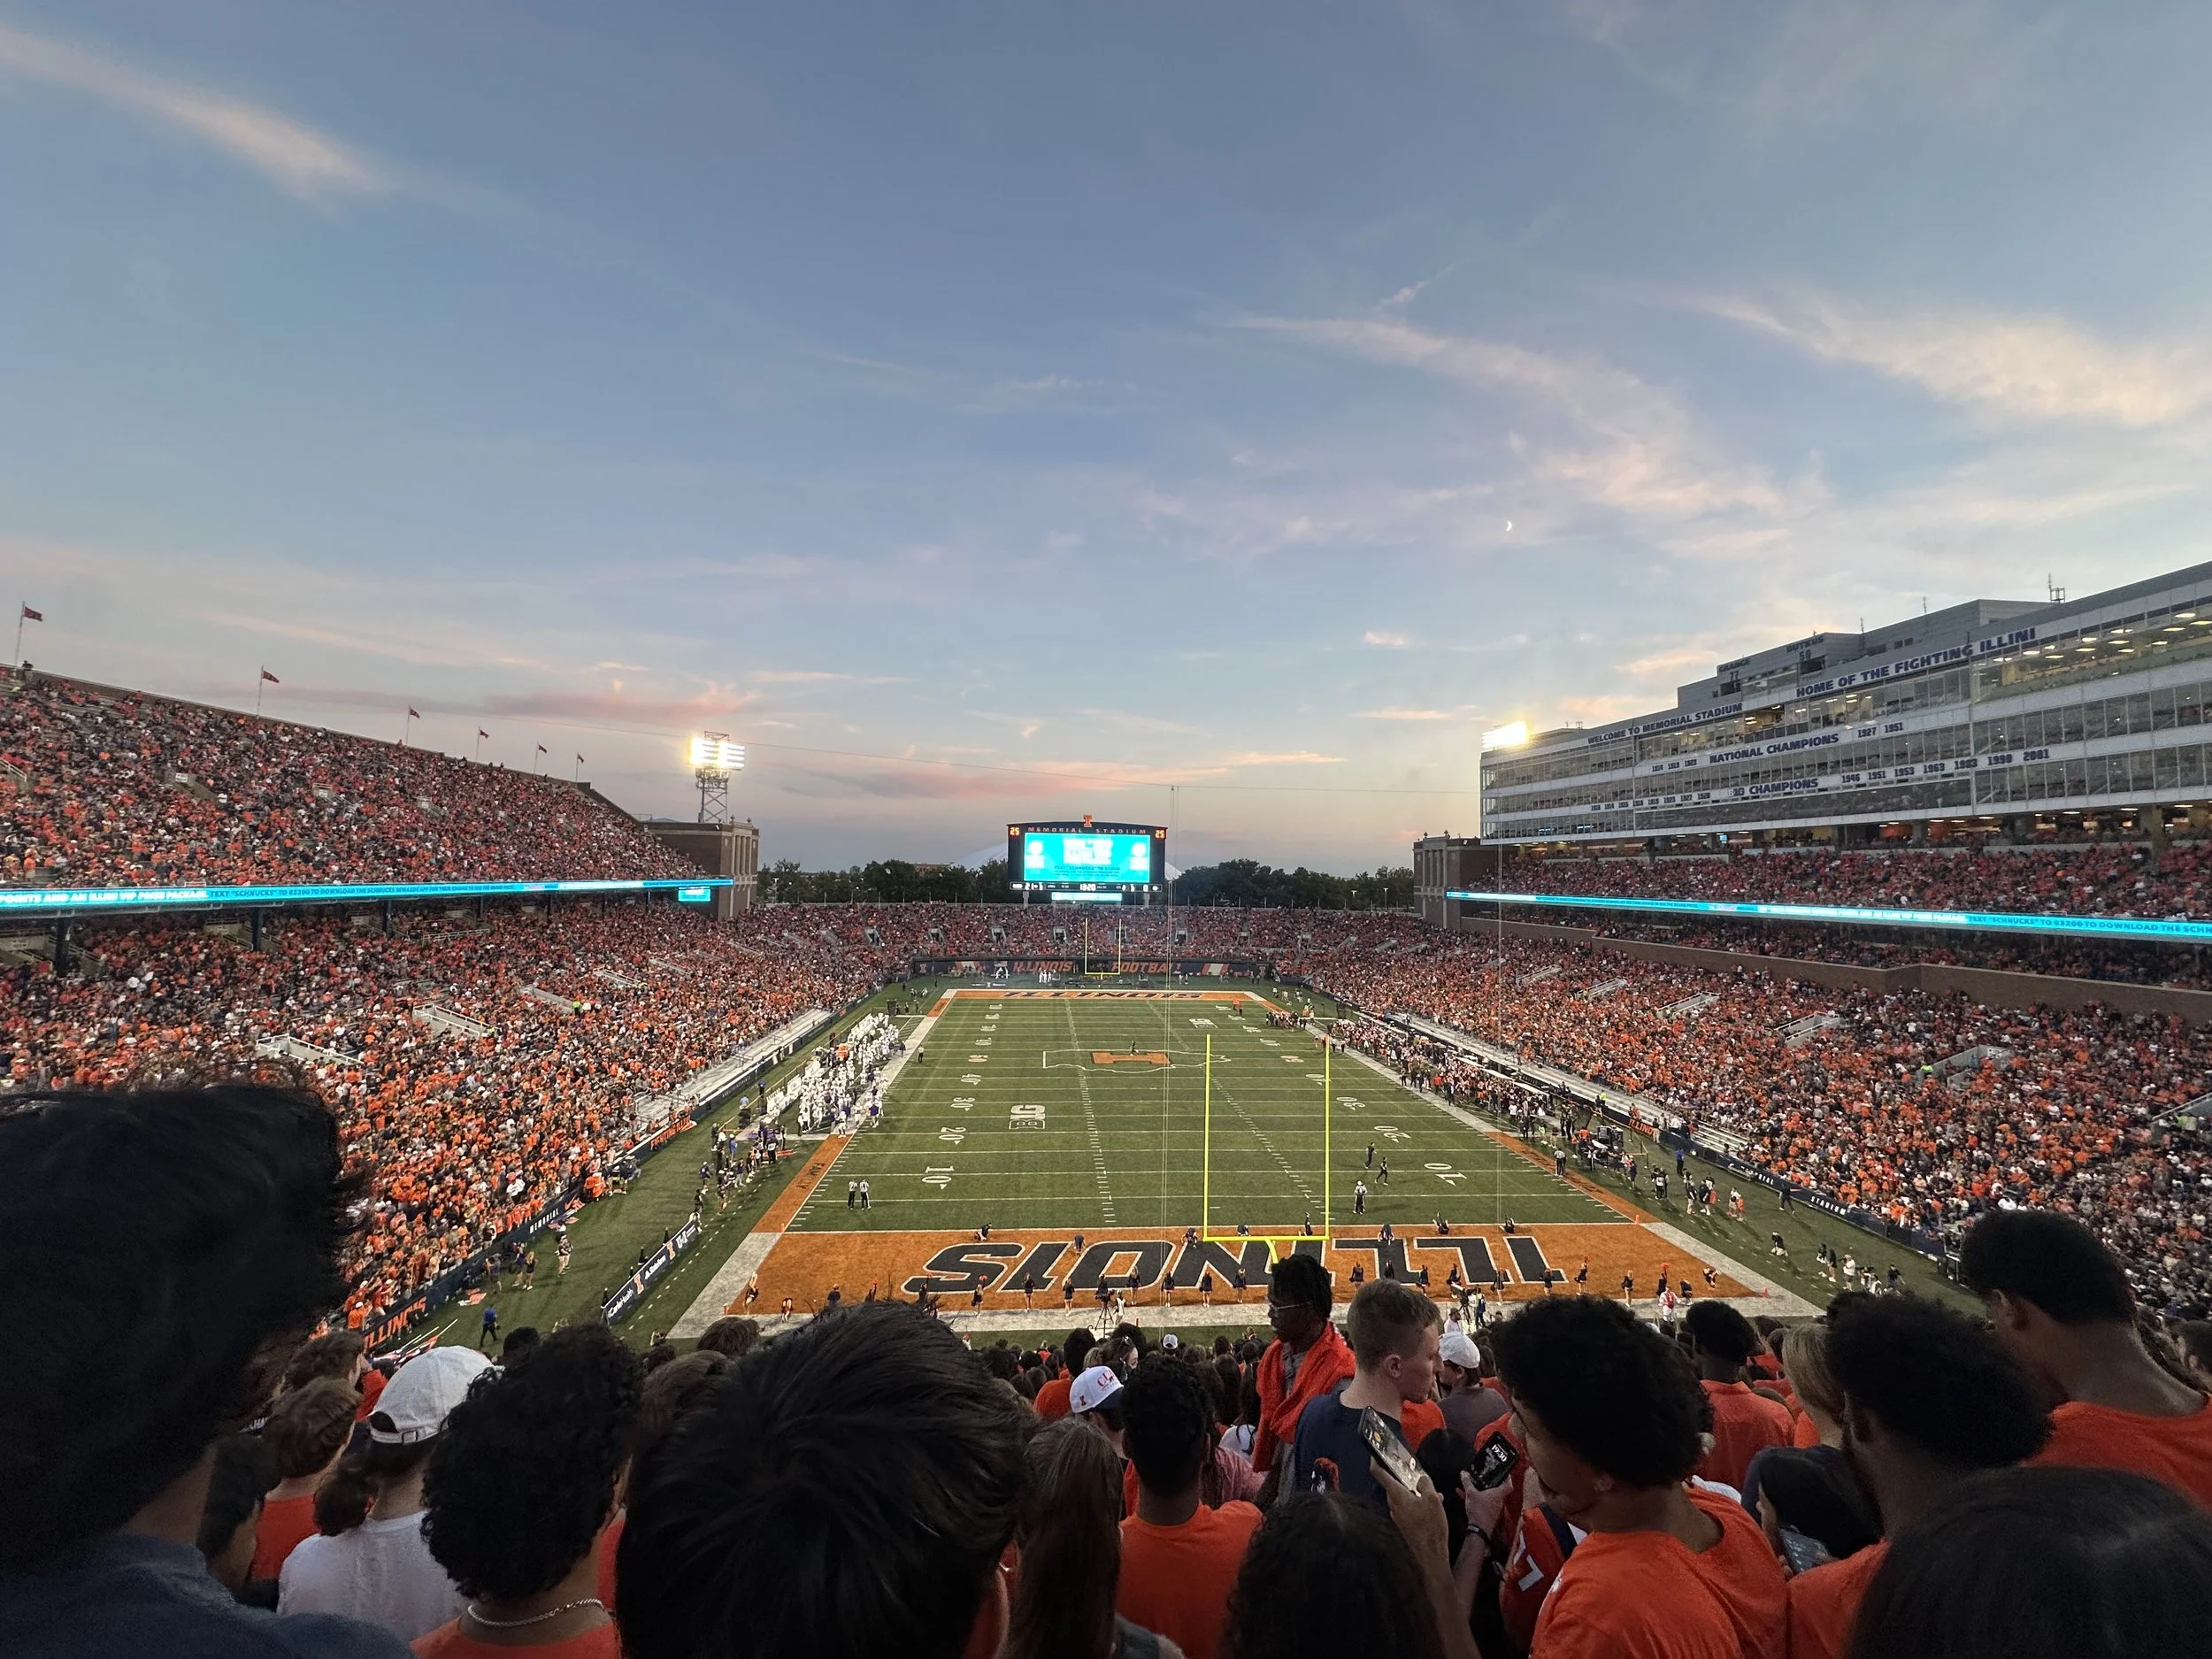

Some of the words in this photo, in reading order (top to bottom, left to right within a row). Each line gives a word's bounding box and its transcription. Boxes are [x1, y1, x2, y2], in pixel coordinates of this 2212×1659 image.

[1786, 635, 1824, 653] BUTKUS
[1796, 680, 1834, 697] HOME
[1838, 673, 1856, 687] OF
[1861, 665, 1889, 682] THE
[1894, 643, 1973, 673] FIGHTING
[1980, 627, 2036, 652] ILLINI
[1588, 727, 1625, 745] WELCOME
[1628, 724, 1640, 738] TO
[1643, 713, 1693, 733] MEMORIAL
[1695, 702, 1743, 721] STADIUM
[1709, 747, 1763, 764] NATIONAL
[1766, 733, 1839, 754] CHAMPIONS
[1858, 726, 1876, 738] 1927
[1885, 721, 1903, 733] 1951
[1749, 779, 1818, 795] CHAMPIONS
[1894, 766, 1915, 778] 1953
[2099, 922, 2159, 932] DOWNLOAD
[950, 1097, 975, 1108] 30
[1336, 1096, 1366, 1108] 30
[939, 1126, 966, 1141] 20
[1373, 1125, 1411, 1140] 20
[921, 1165, 955, 1184] 10
[1424, 1163, 1467, 1180] 10
[1810, 1196, 1847, 1216] STADIUM
[364, 1296, 426, 1354] ILLINS
